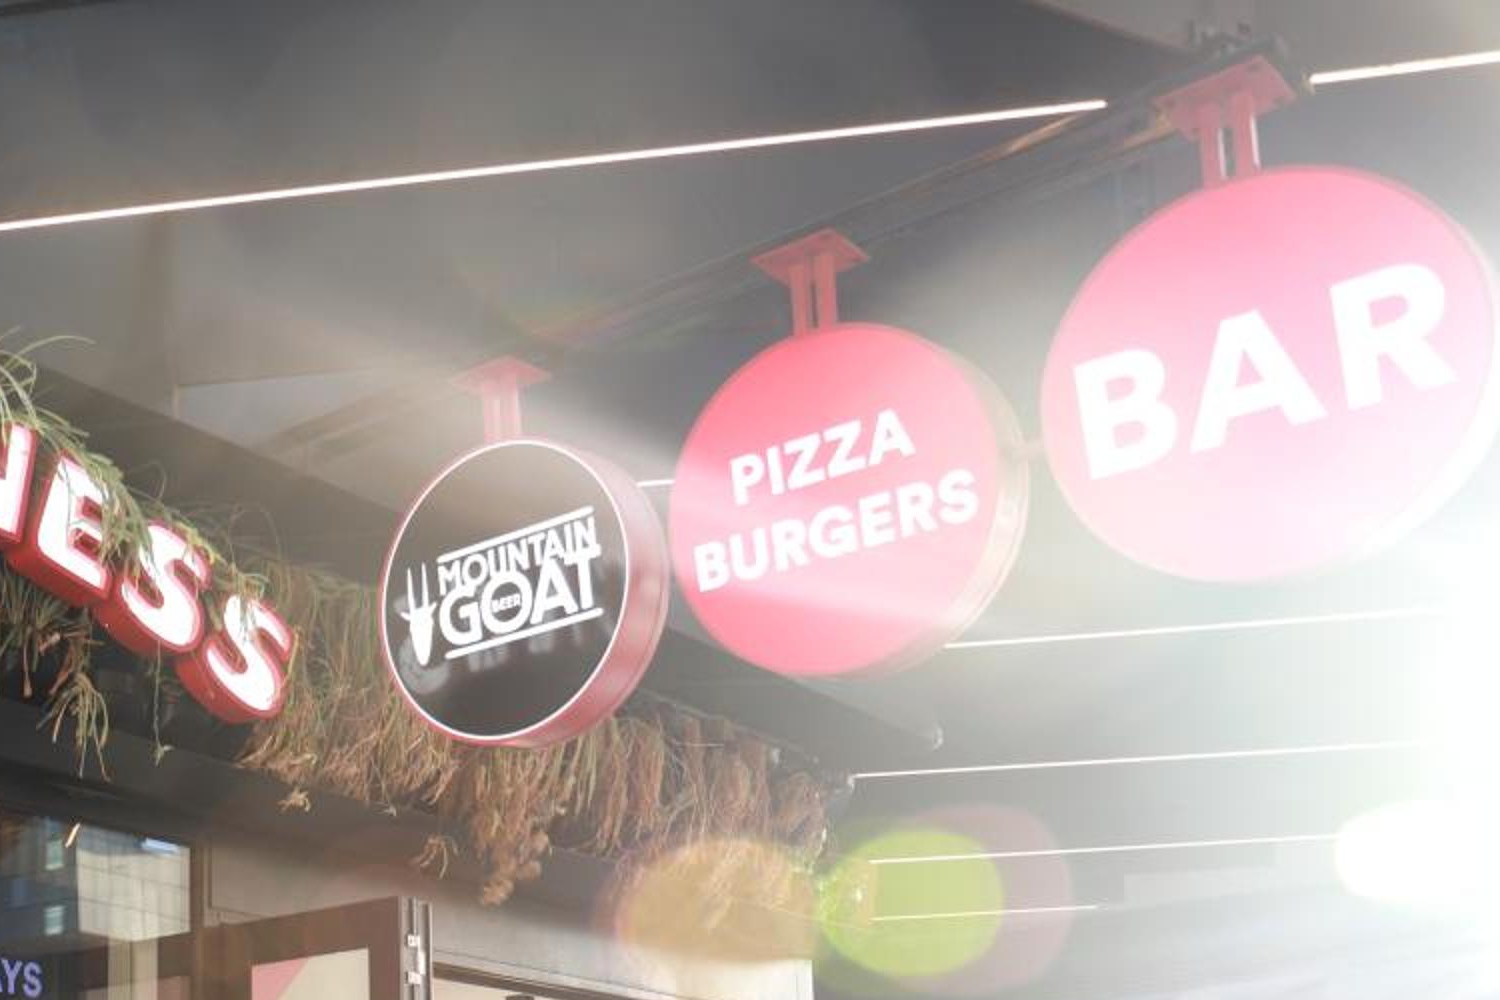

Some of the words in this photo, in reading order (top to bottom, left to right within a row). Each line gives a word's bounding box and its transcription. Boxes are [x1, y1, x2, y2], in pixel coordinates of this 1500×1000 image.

[1073, 263, 1457, 480] BAR
[730, 409, 916, 505] PIZZA
[437, 514, 597, 596] MOUNTAIN
[693, 469, 980, 593] BURGERS
[439, 544, 601, 646] GOAT
